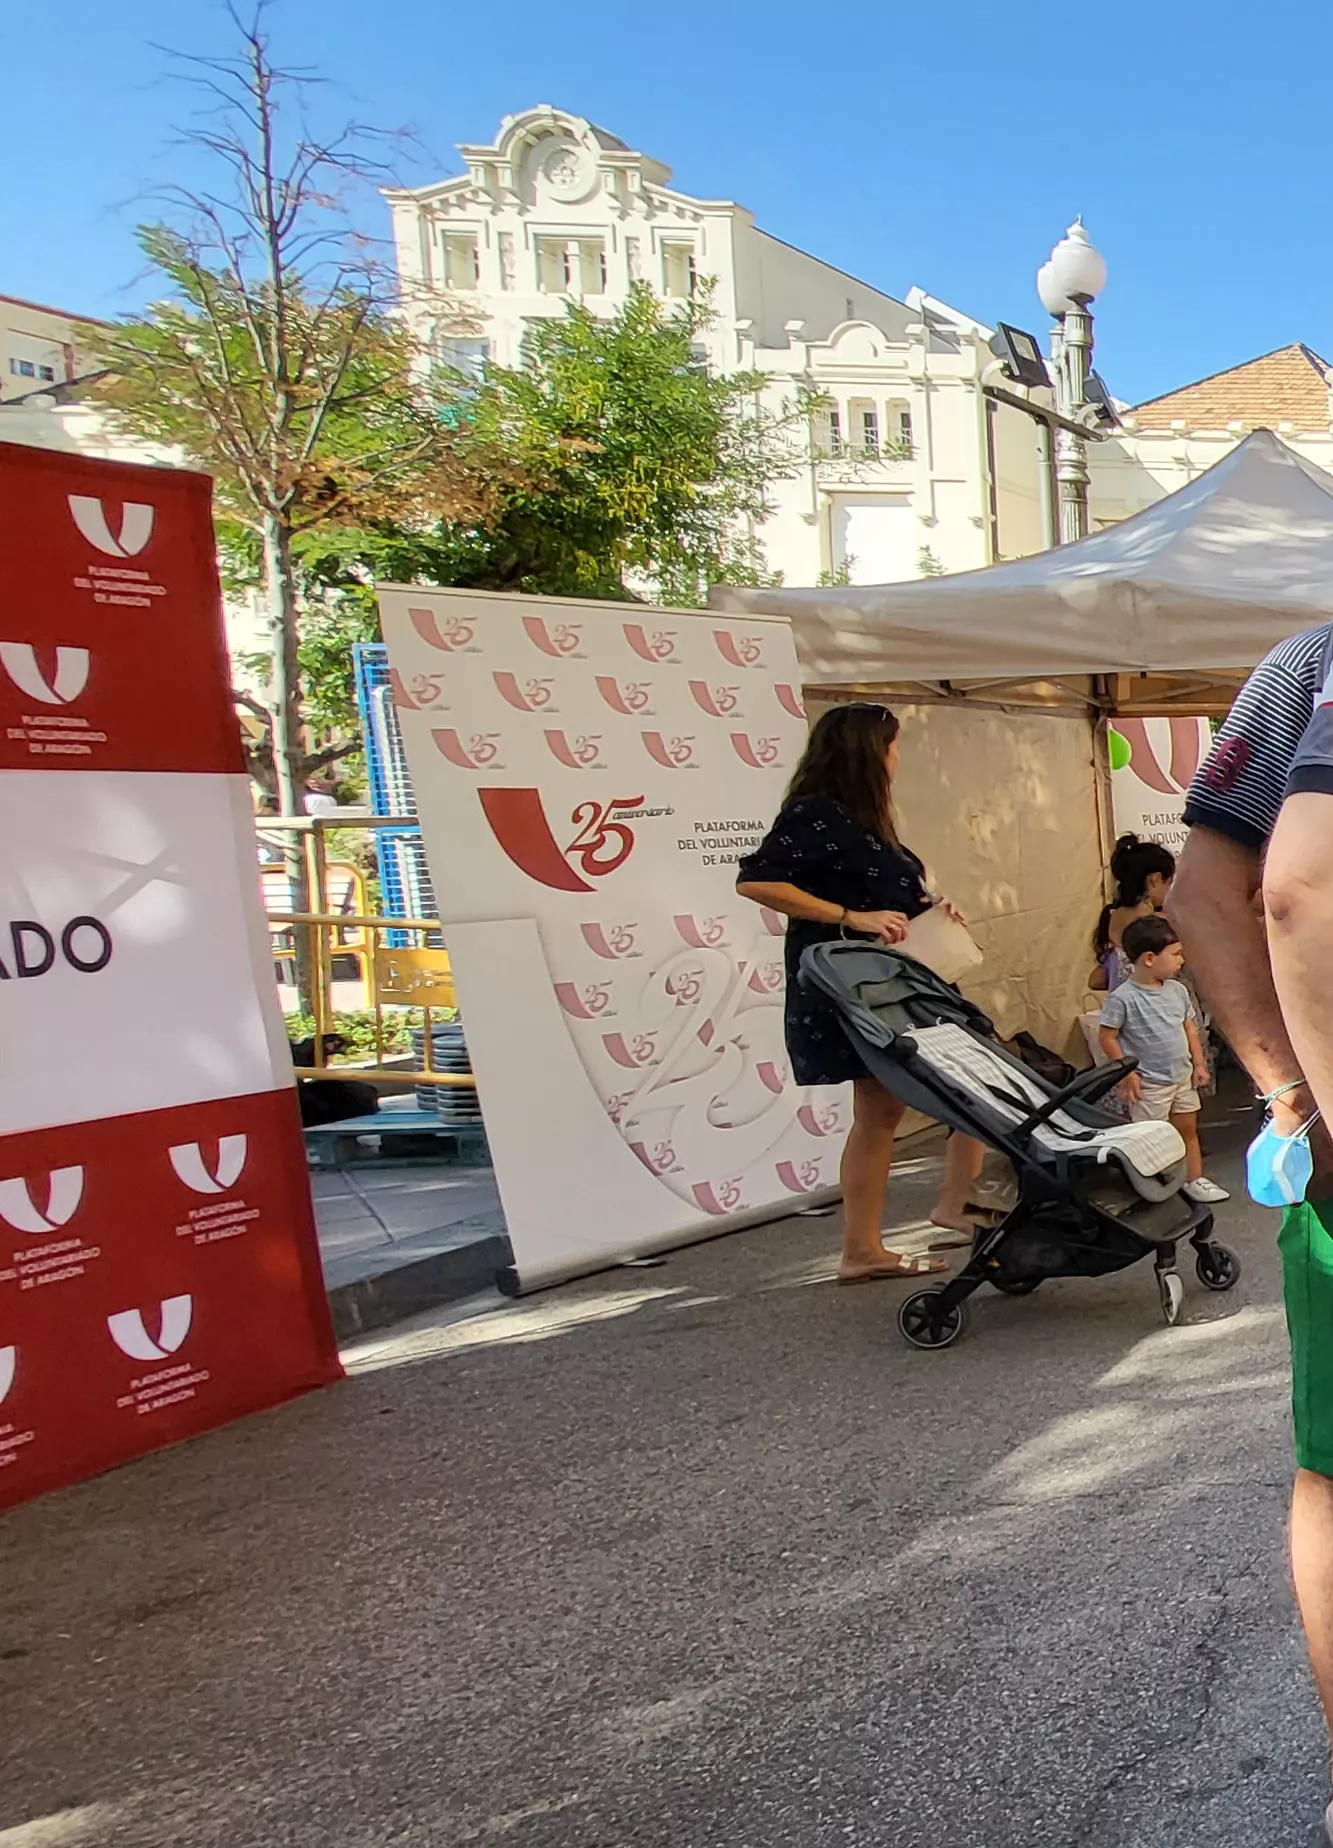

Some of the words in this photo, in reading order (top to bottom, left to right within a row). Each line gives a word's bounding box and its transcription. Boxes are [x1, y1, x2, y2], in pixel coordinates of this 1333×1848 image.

[693, 820, 765, 833] PLATAFORMA
[565, 795, 644, 876] 25
[677, 839, 698, 850] DEL
[700, 836, 765, 849] VOLUNTARI
[702, 854, 717, 866] DE
[0, 915, 113, 980] DO
